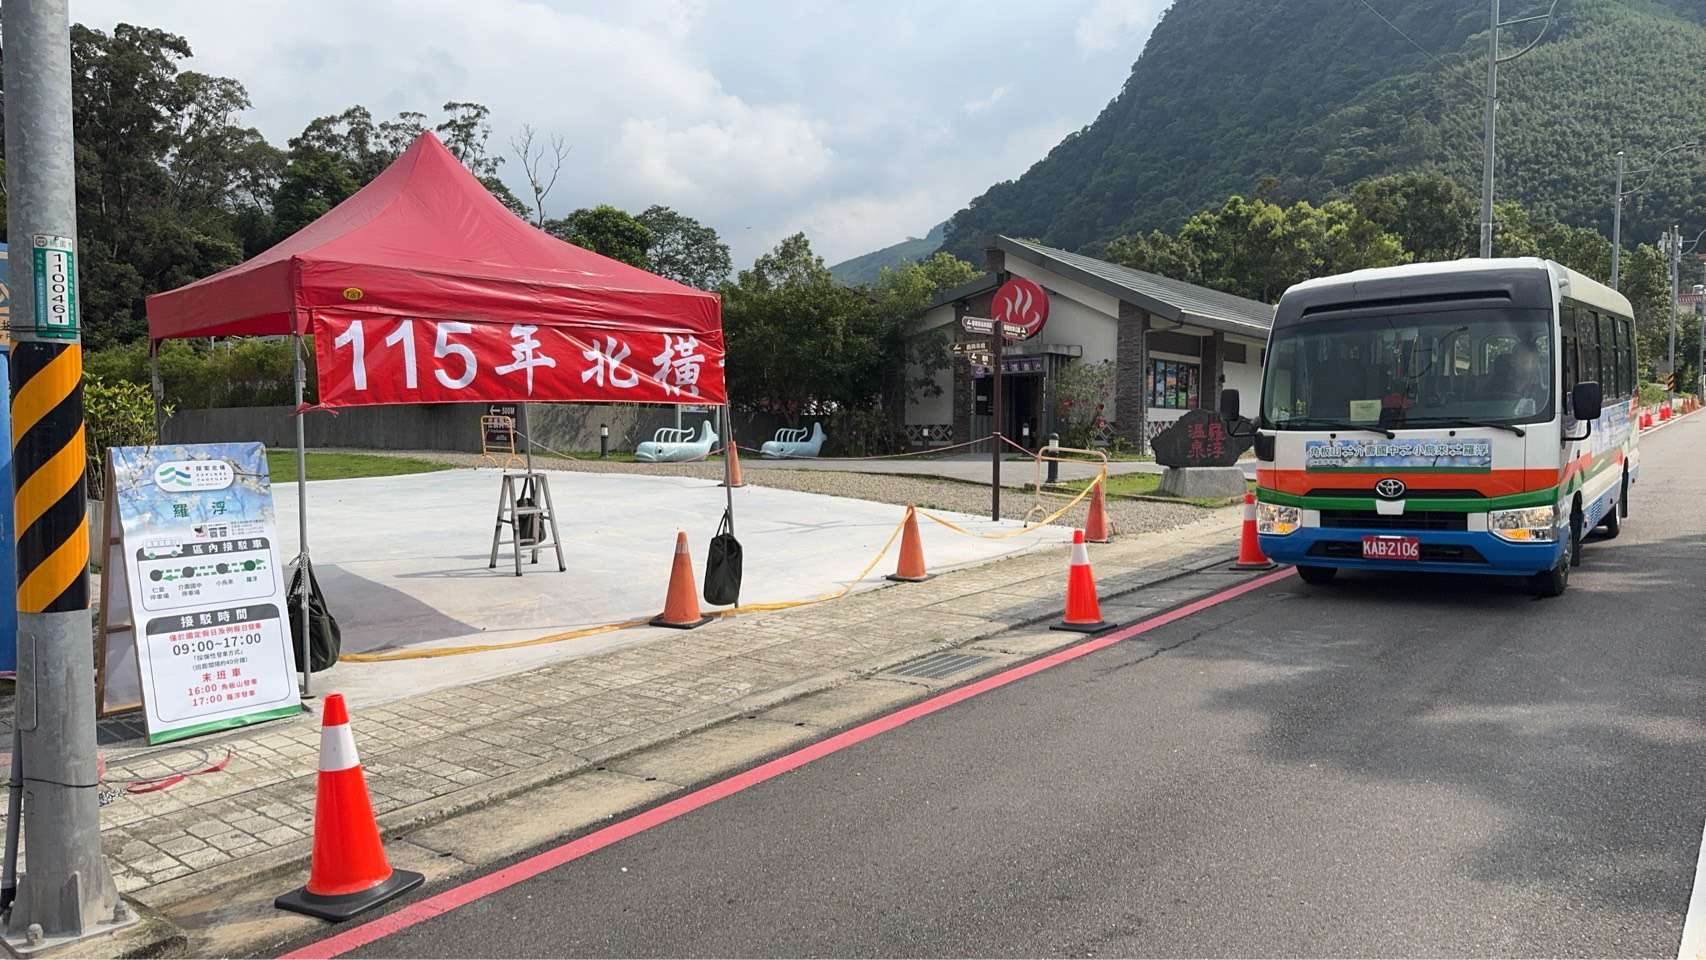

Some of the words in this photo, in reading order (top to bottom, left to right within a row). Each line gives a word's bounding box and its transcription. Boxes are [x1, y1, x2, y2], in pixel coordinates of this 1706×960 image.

[52, 253, 65, 324] 1100461
[334, 319, 725, 397] 115年北橫
[173, 500, 228, 518] 羅浮
[180, 608, 248, 628] 接駁時間
[173, 633, 261, 656] 09:00~17:00
[202, 668, 241, 682] 末班車
[188, 684, 217, 696] 16:00
[193, 695, 222, 706] 17:00
